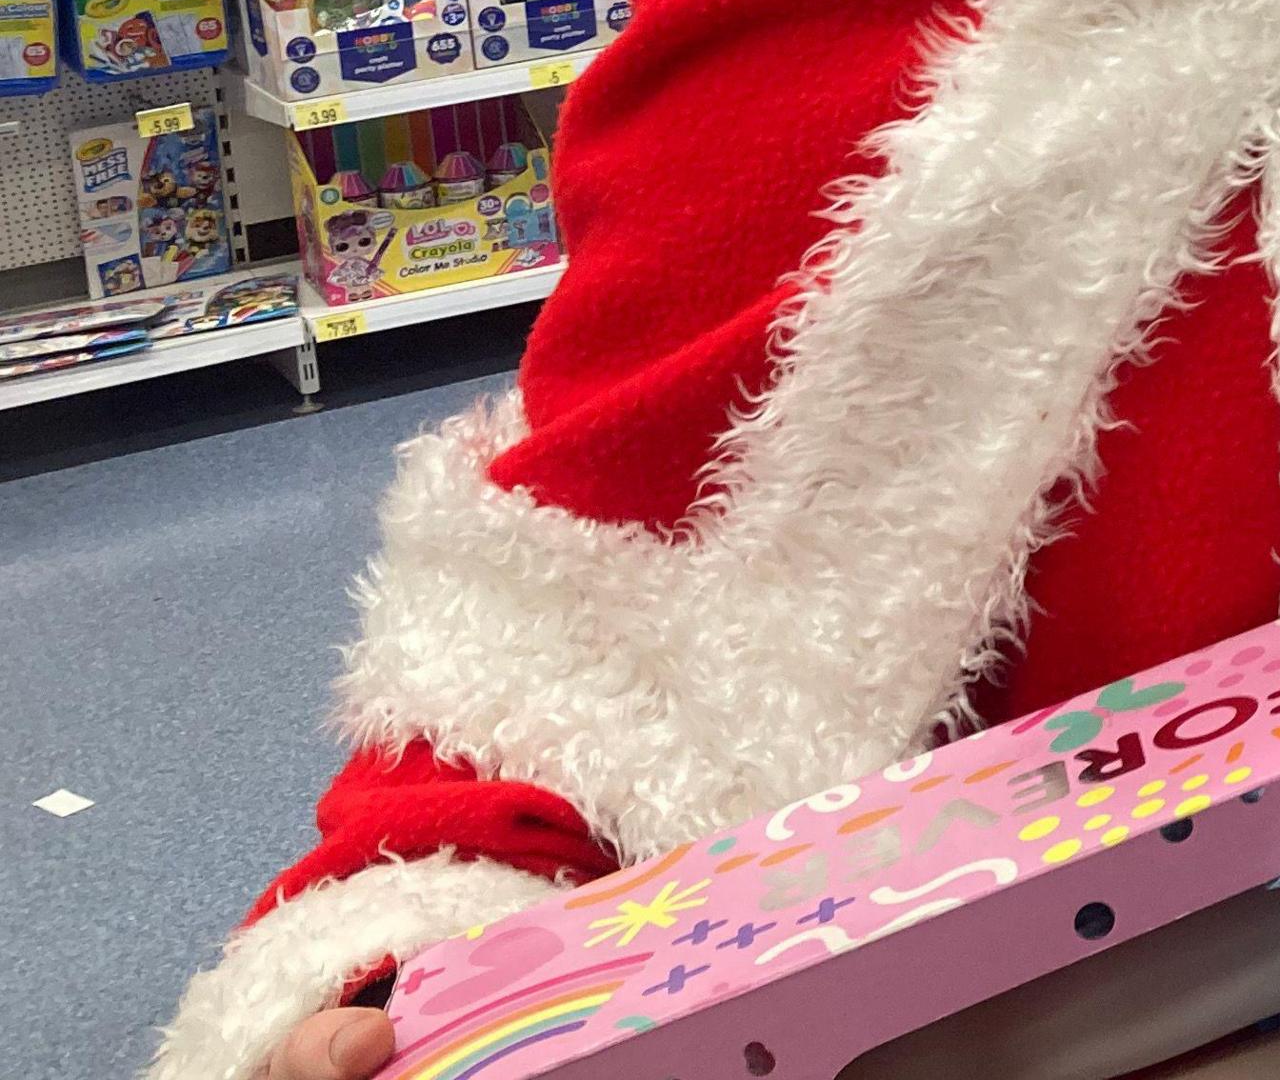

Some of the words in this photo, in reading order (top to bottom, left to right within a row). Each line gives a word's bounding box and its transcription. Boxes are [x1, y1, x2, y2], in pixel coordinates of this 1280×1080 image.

[199, 22, 218, 36] 65
[27, 46, 46, 58] 65
[431, 39, 456, 52] 655
[82, 151, 128, 178] MESS
[84, 163, 130, 188] FREE
[410, 238, 474, 261] Crayola
[399, 262, 428, 278] Color
[430, 261, 451, 273] Me
